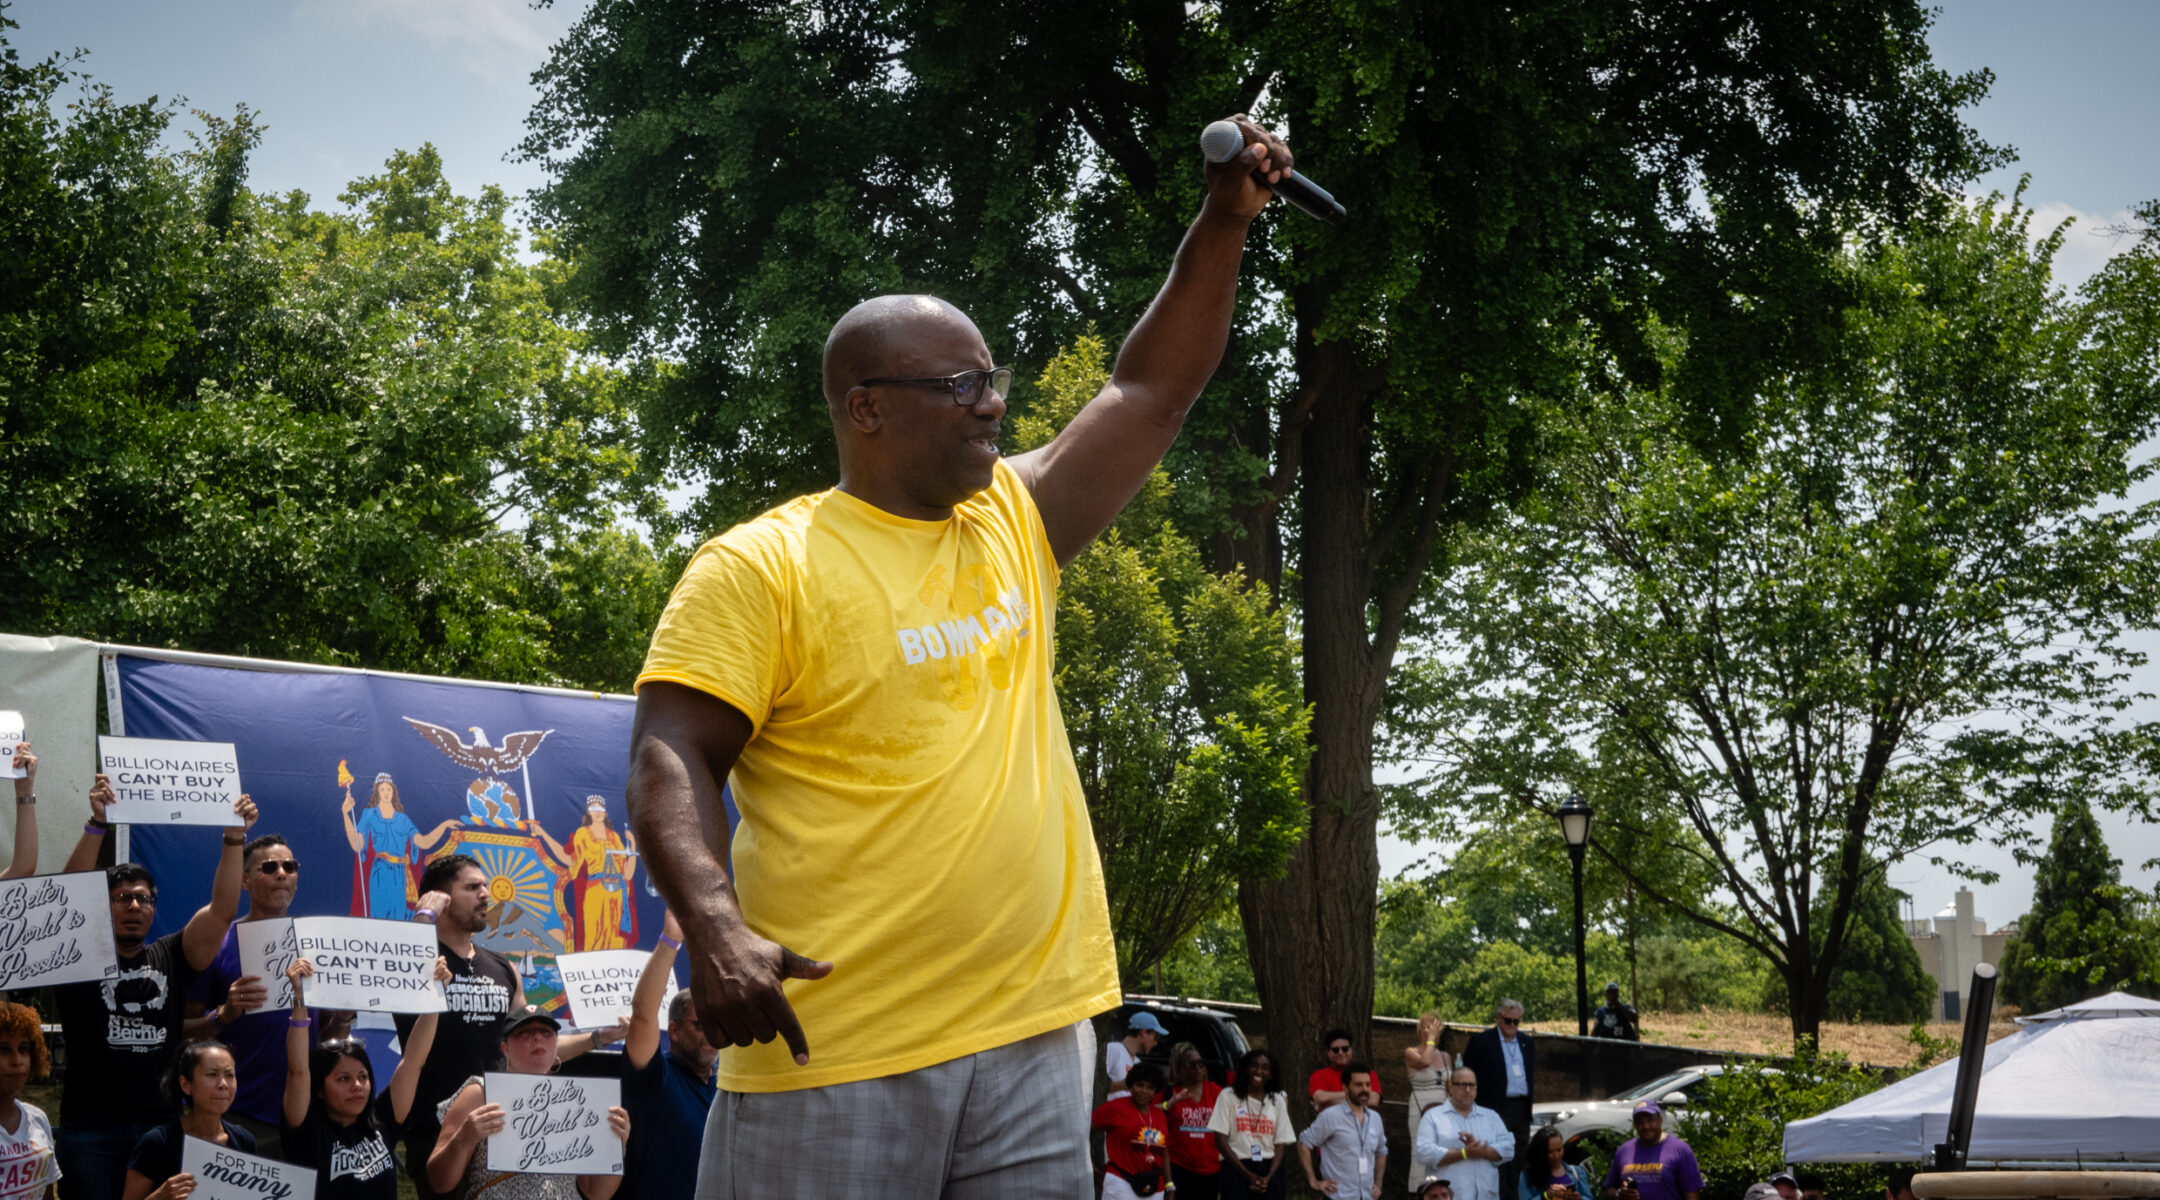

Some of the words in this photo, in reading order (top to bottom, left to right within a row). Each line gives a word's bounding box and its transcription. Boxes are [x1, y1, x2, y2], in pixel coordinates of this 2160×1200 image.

[104, 756, 236, 774] BILLIONAIRES
[118, 772, 178, 786] CAN'T
[186, 776, 225, 788] BUY
[115, 788, 154, 801] THE
[162, 789, 231, 804] BRONX
[68, 910, 86, 930] is
[300, 937, 436, 959] BILLIONAIRES
[0, 938, 82, 988] Possible
[315, 954, 378, 970] CAN'T
[385, 959, 425, 974] BUY
[313, 970, 353, 986] THE
[360, 974, 431, 991] BRONX
[580, 981, 634, 994] CAN'T
[581, 996, 616, 1008] THE
[108, 1014, 143, 1027] NYC
[463, 1013, 471, 1023] of
[108, 1025, 167, 1040] Bernie
[528, 1079, 586, 1112] Better
[512, 1107, 585, 1140] World
[583, 1110, 600, 1127] is
[518, 1136, 594, 1170] Possible
[216, 1152, 245, 1170] FOR
[251, 1161, 280, 1179] THE
[202, 1162, 292, 1200] many
